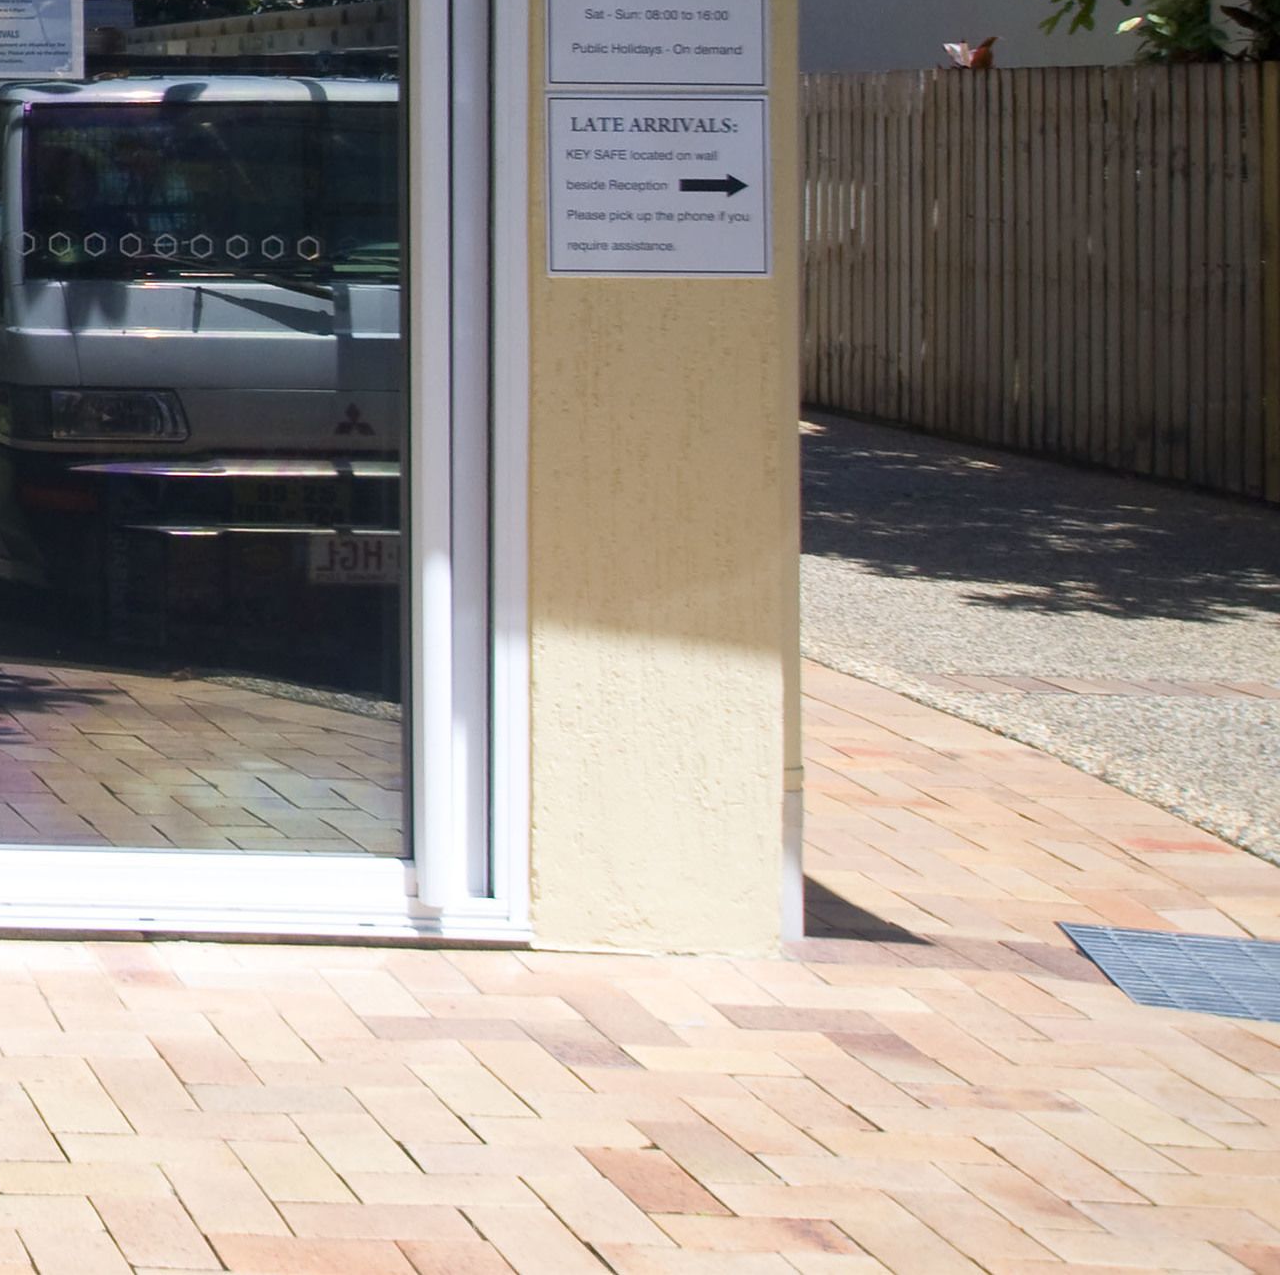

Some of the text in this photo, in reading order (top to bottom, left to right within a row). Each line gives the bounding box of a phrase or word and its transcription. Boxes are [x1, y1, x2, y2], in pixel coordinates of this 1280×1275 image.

[585, 8, 605, 20] Sat
[681, 10, 693, 21] to
[572, 42, 609, 54] Public
[611, 43, 662, 57] Holidays
[672, 43, 690, 55] On
[694, 44, 743, 55] demand
[570, 117, 738, 134] LATE ARRIVALS:
[566, 149, 718, 161] KEY SAFE located on wall
[566, 179, 668, 193] beside Reception
[567, 209, 606, 220] Please
[608, 210, 634, 223] pick
[636, 212, 652, 223] up
[655, 211, 674, 221] the
[677, 211, 715, 223] phone
[727, 213, 750, 224] you
[567, 241, 609, 253] require
